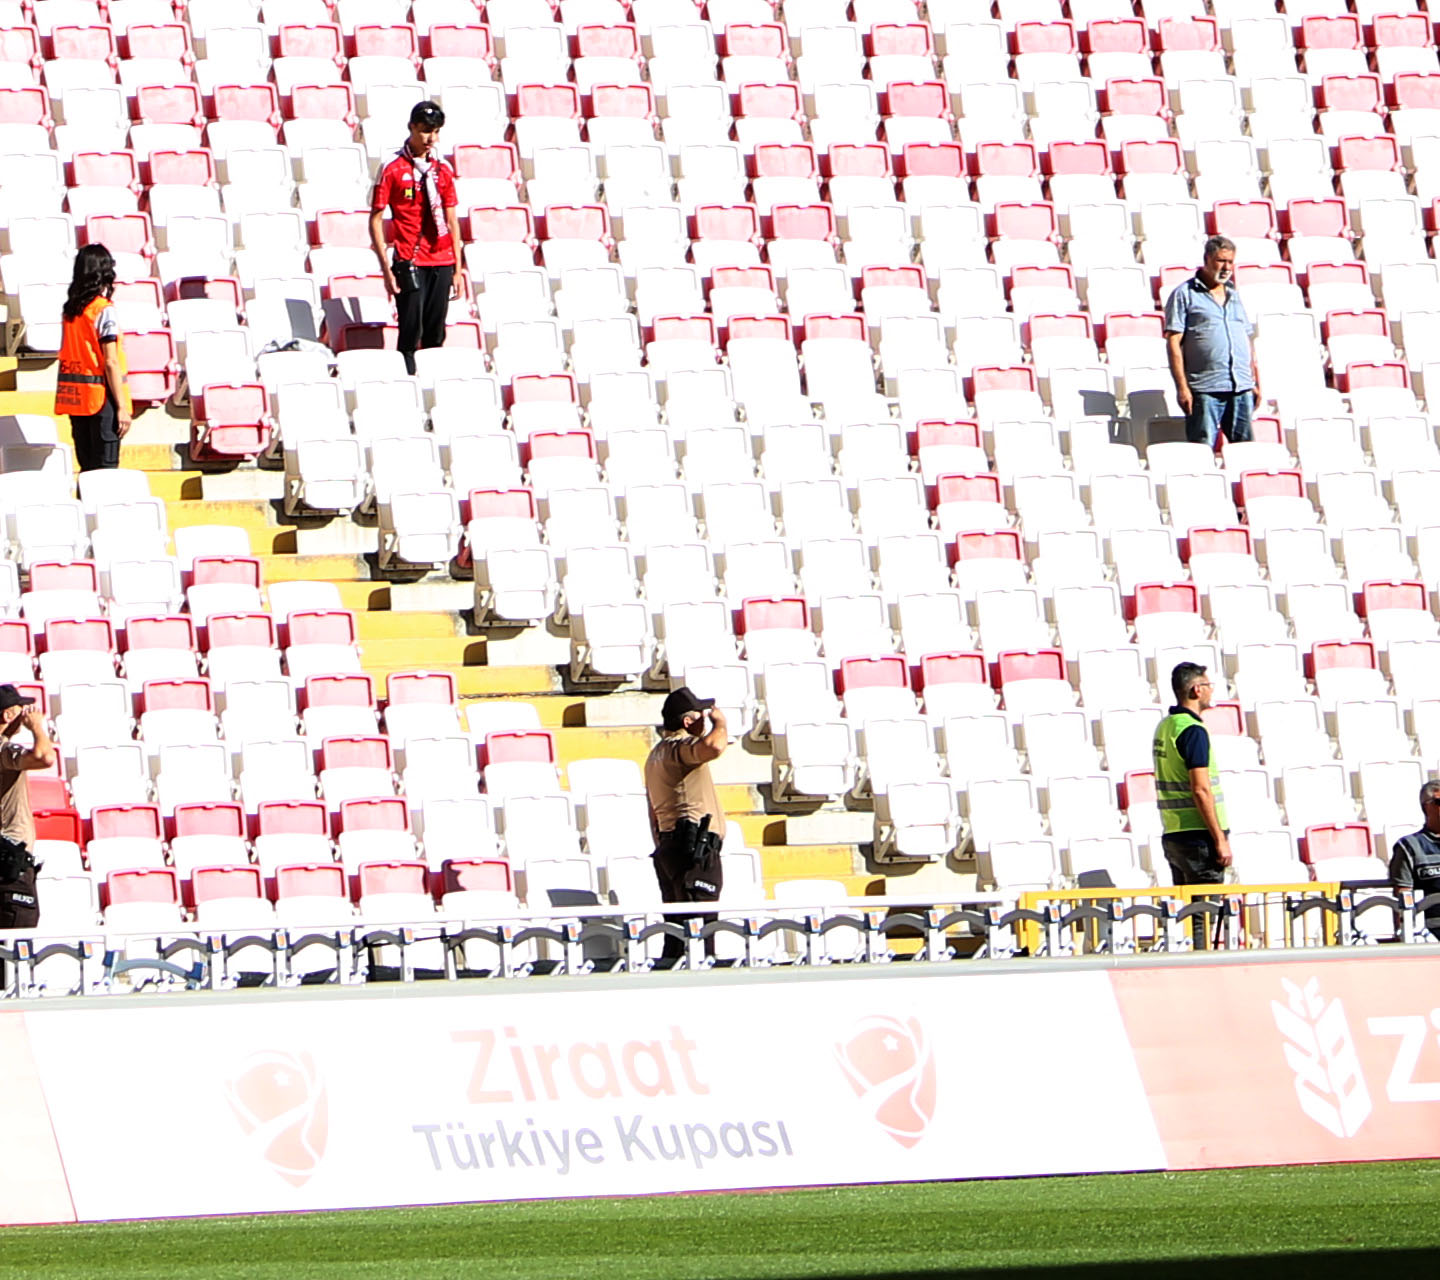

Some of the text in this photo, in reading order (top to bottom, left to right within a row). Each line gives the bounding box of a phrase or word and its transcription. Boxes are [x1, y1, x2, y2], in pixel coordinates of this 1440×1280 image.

[449, 1025, 712, 1107] Ziraat
[411, 1108, 795, 1179] Türkiye Kupası
